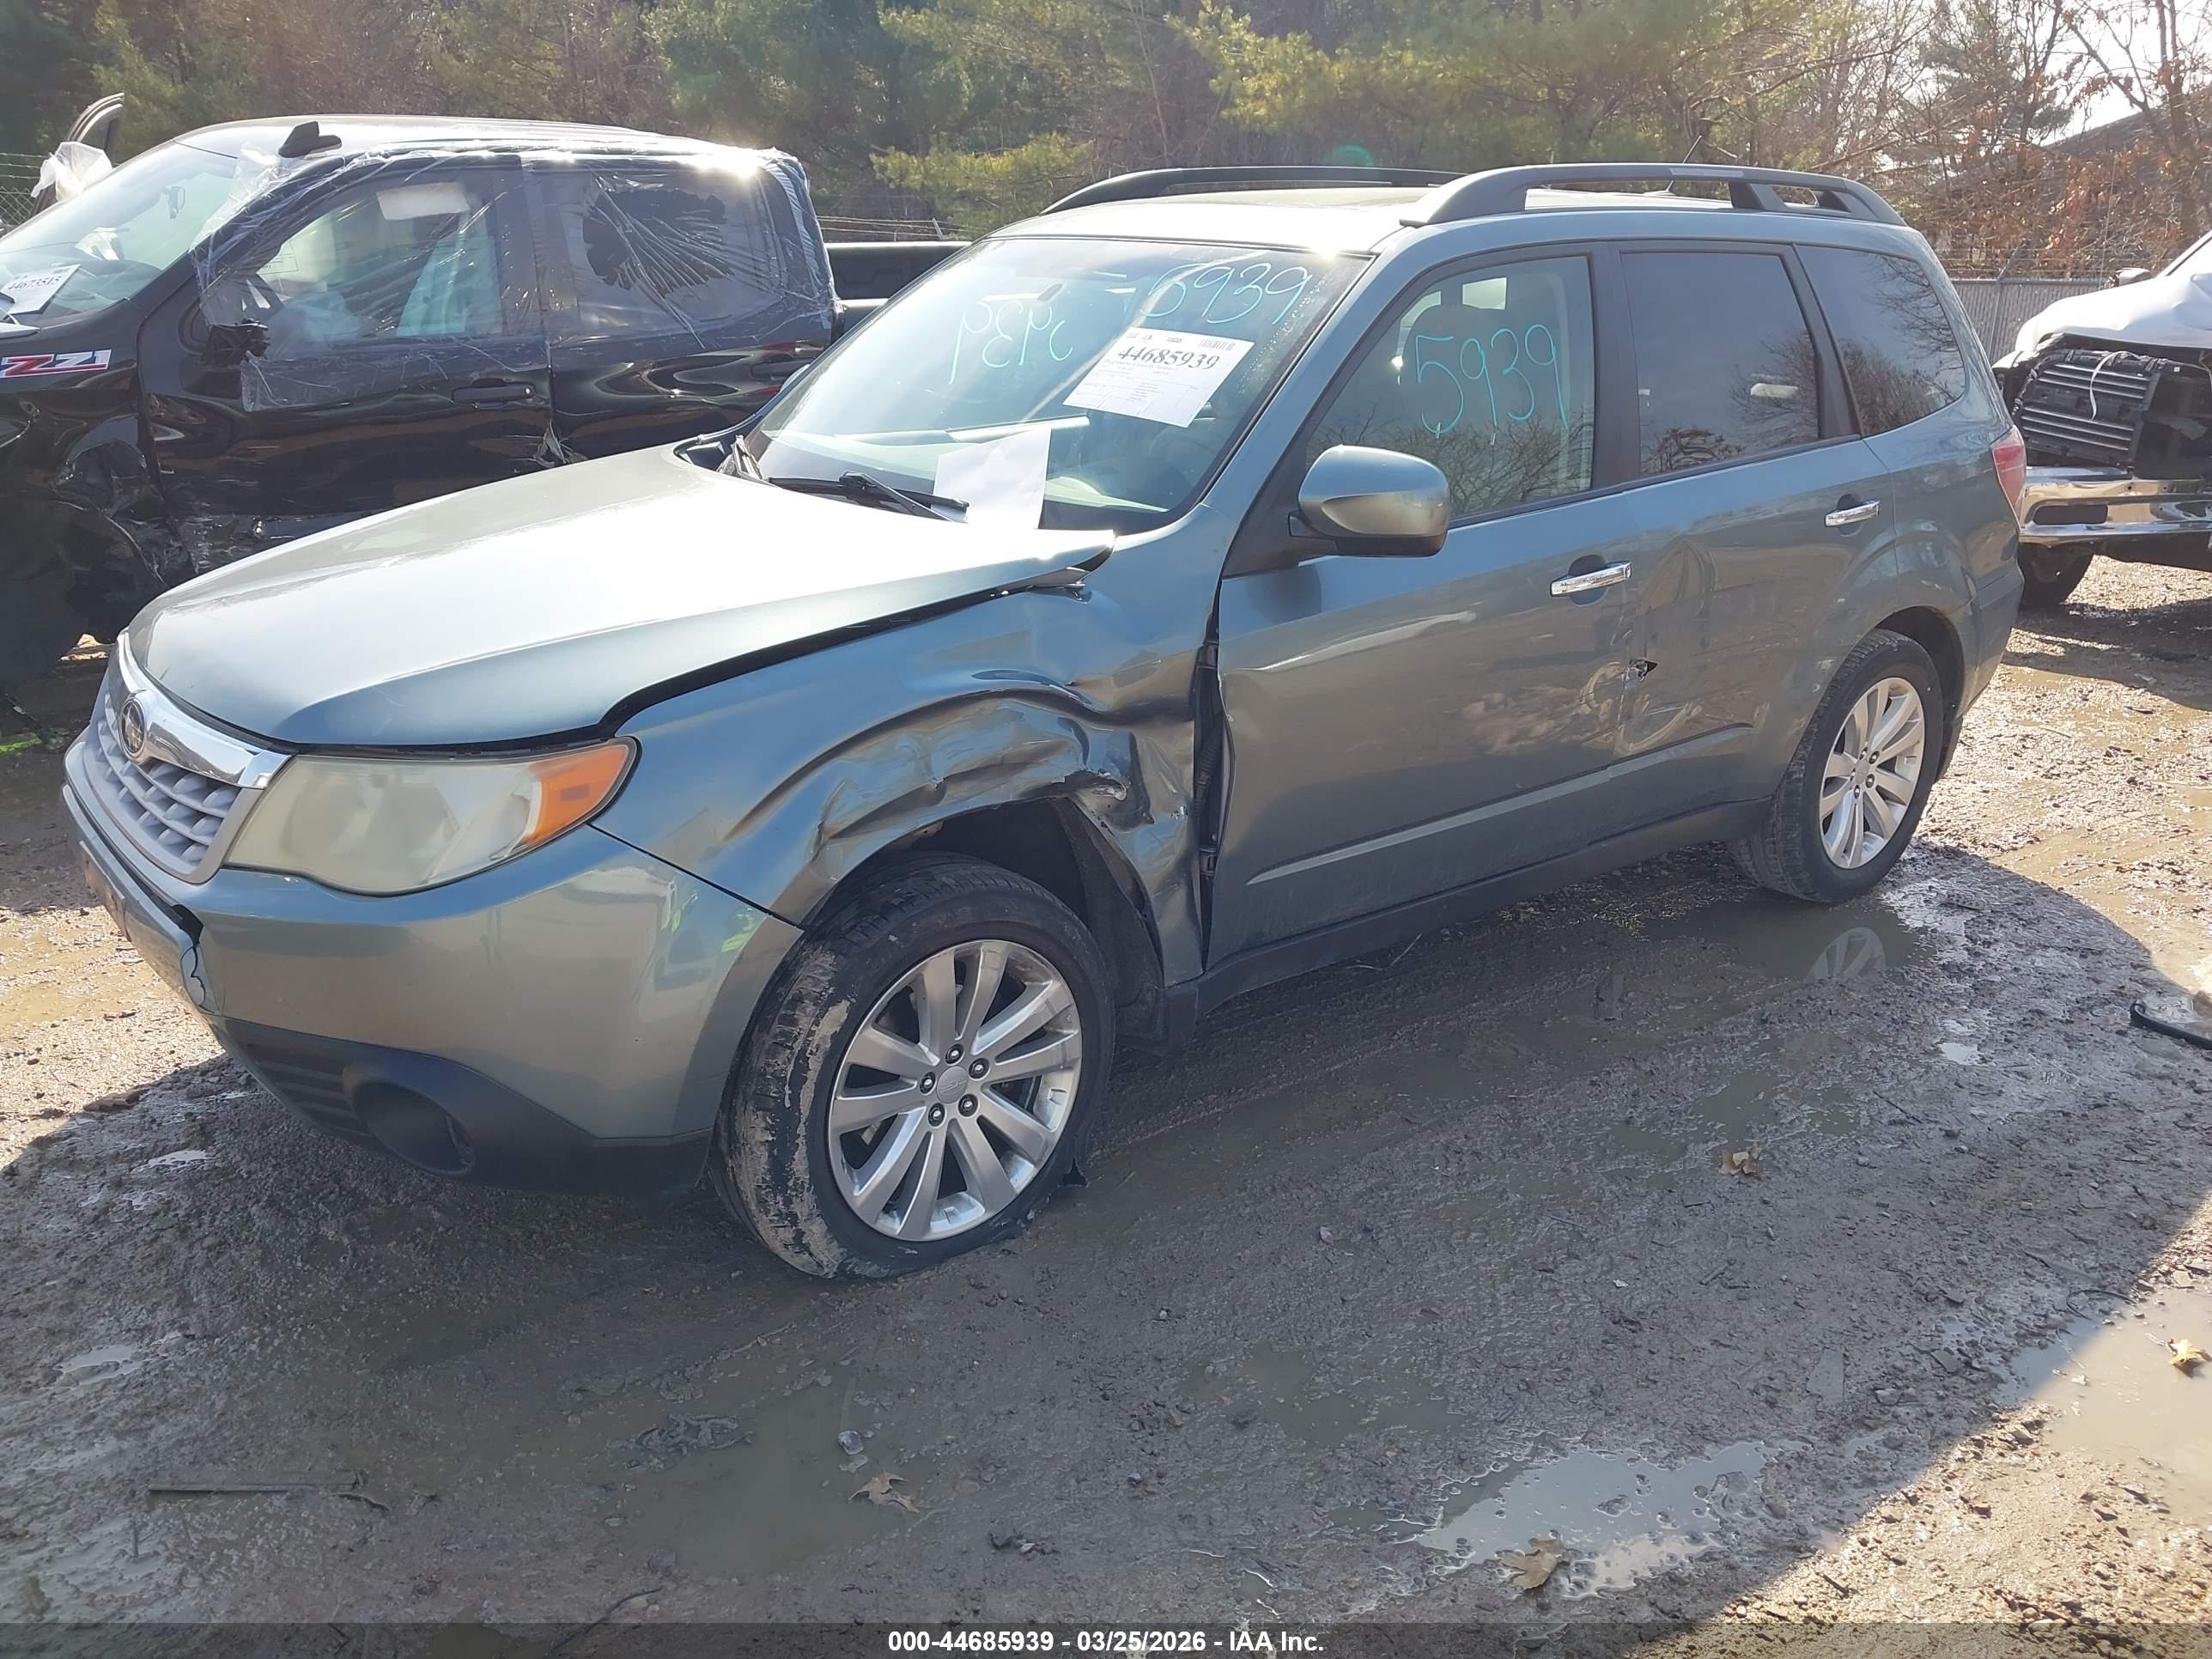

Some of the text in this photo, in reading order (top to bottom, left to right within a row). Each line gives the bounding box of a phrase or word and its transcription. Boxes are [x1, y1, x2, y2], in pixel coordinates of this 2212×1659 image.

[0, 349, 112, 378] Z71
[1117, 345, 1220, 370] 44685939
[1415, 323, 1569, 434] 5939
